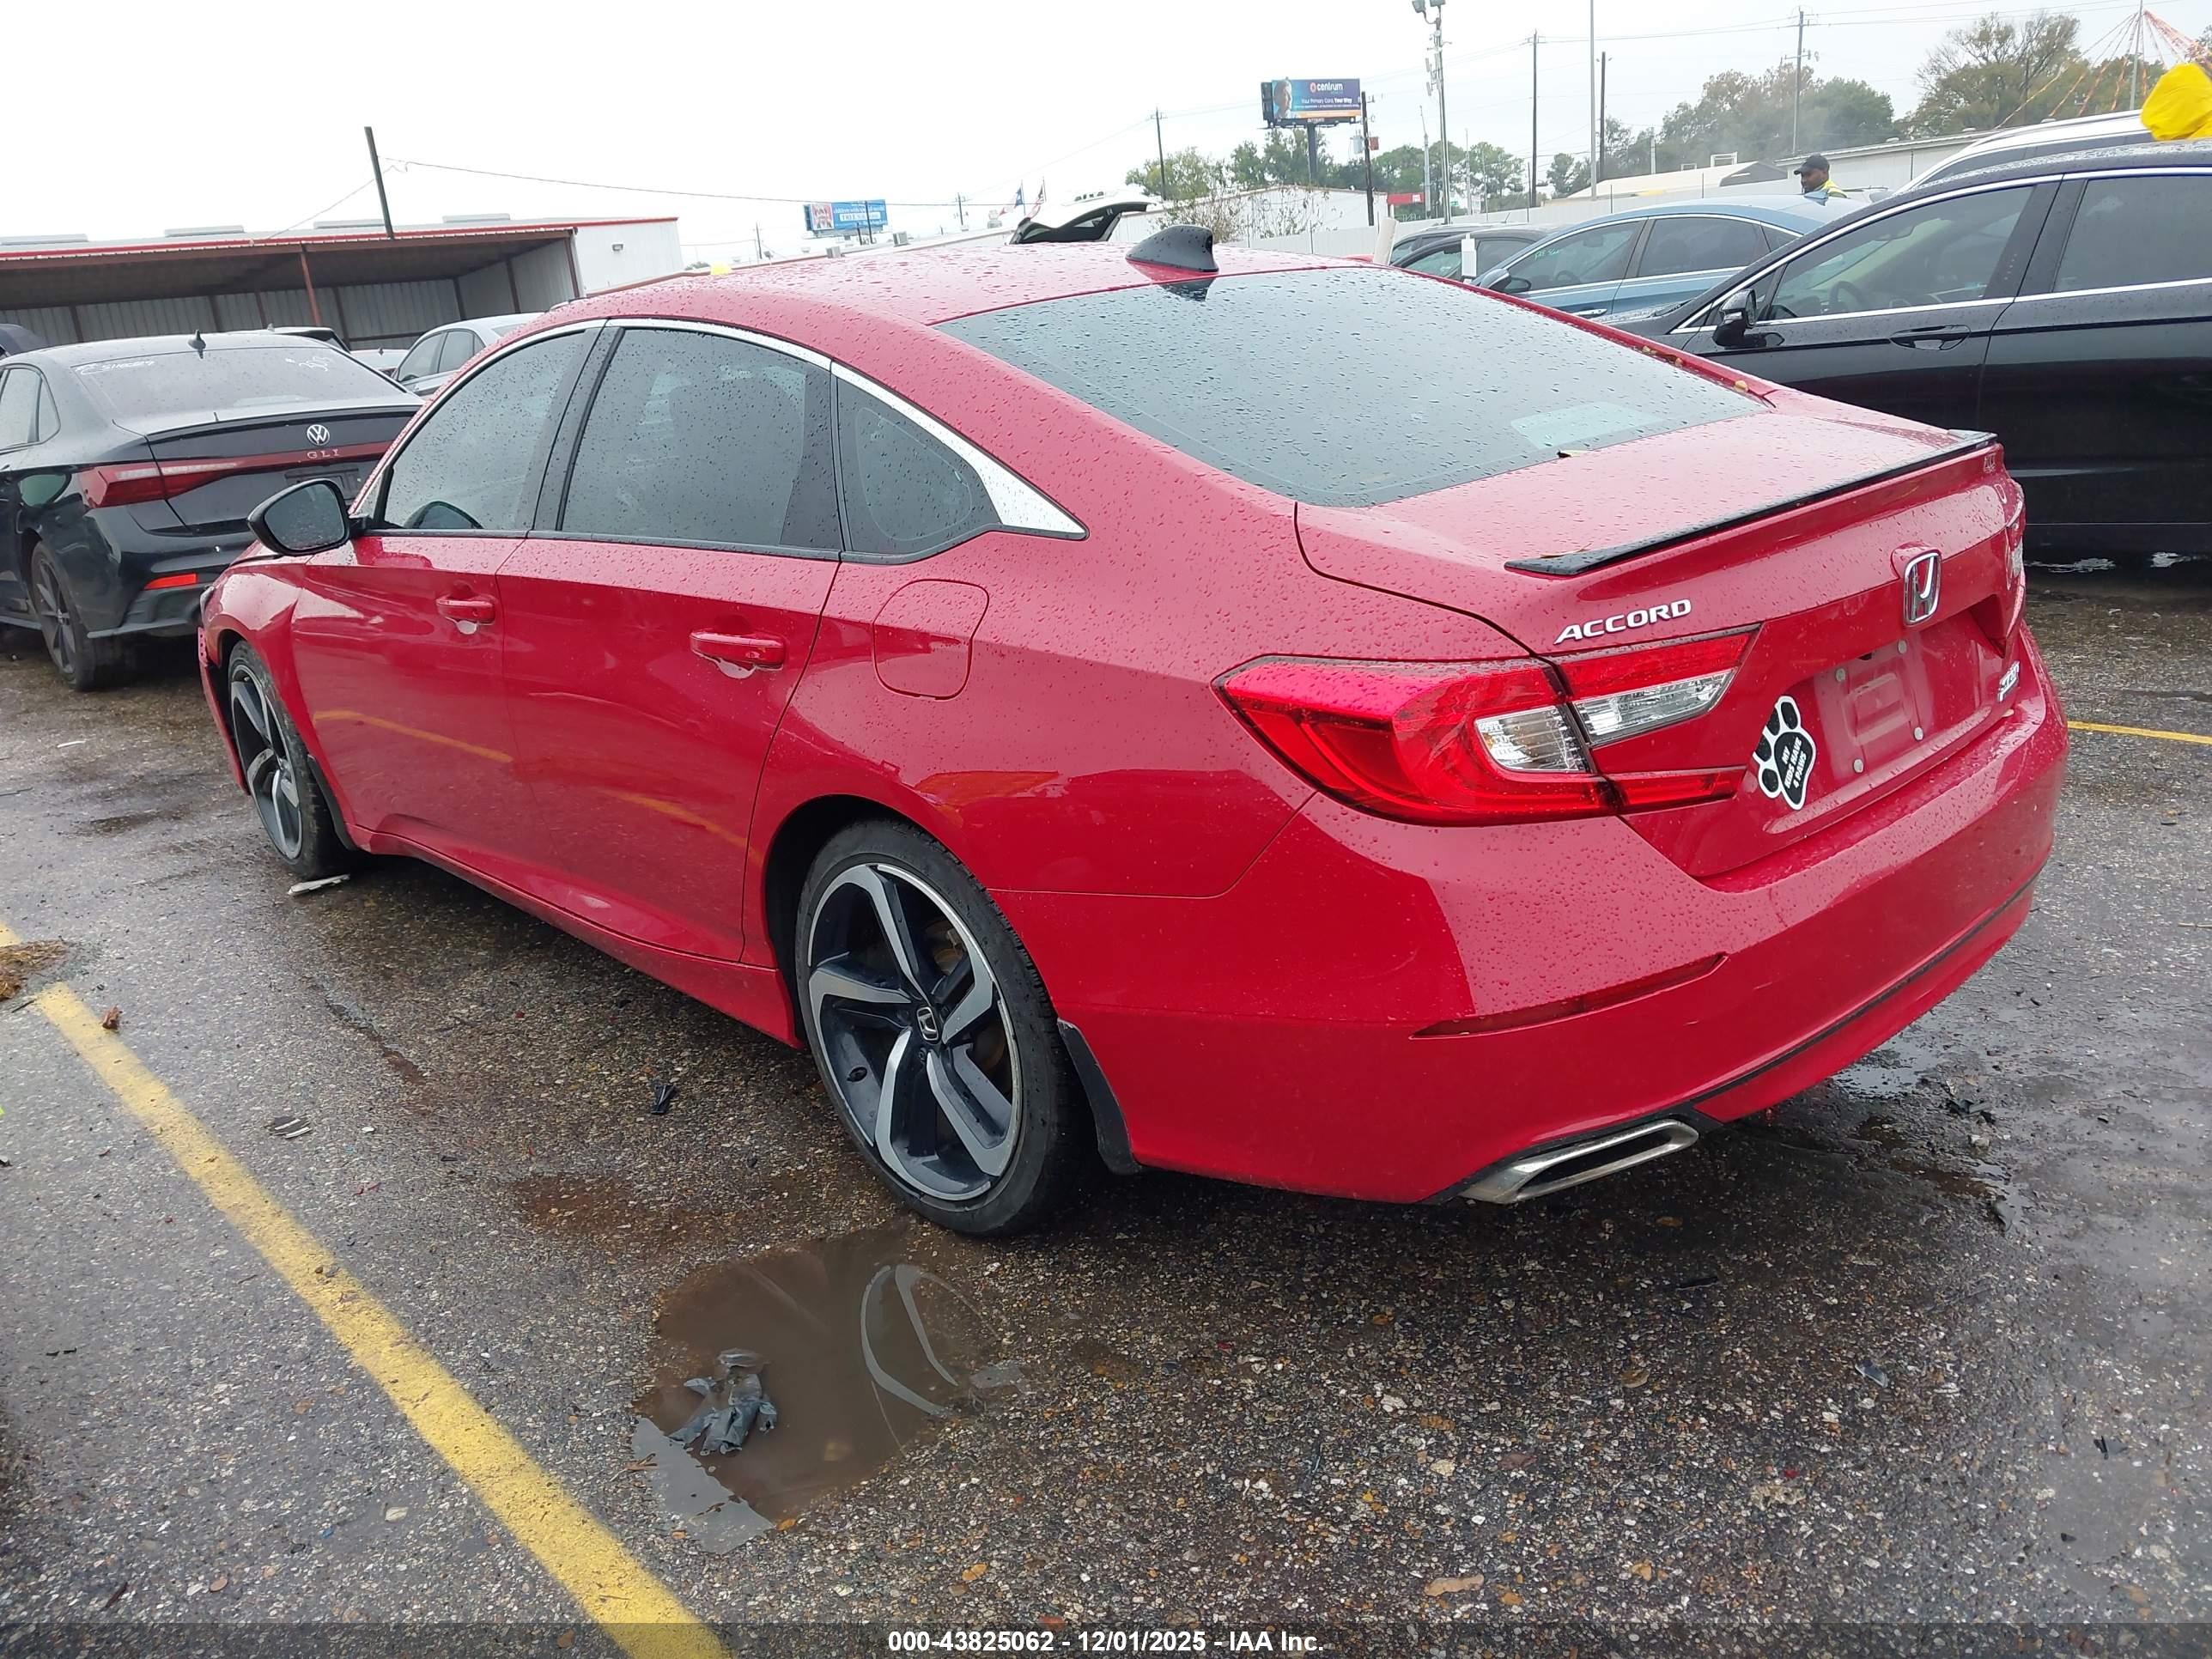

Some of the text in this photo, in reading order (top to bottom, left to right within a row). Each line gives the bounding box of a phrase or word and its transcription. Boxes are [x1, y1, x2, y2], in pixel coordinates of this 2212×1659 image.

[1316, 82, 1343, 91] centrum
[307, 448, 341, 459] GLI
[1553, 599, 1692, 645] ACCORD
[1781, 744, 1790, 765] MY
[1784, 736, 1802, 789] KIDS HAVE
[1793, 750, 1807, 788] 4 PAWS
